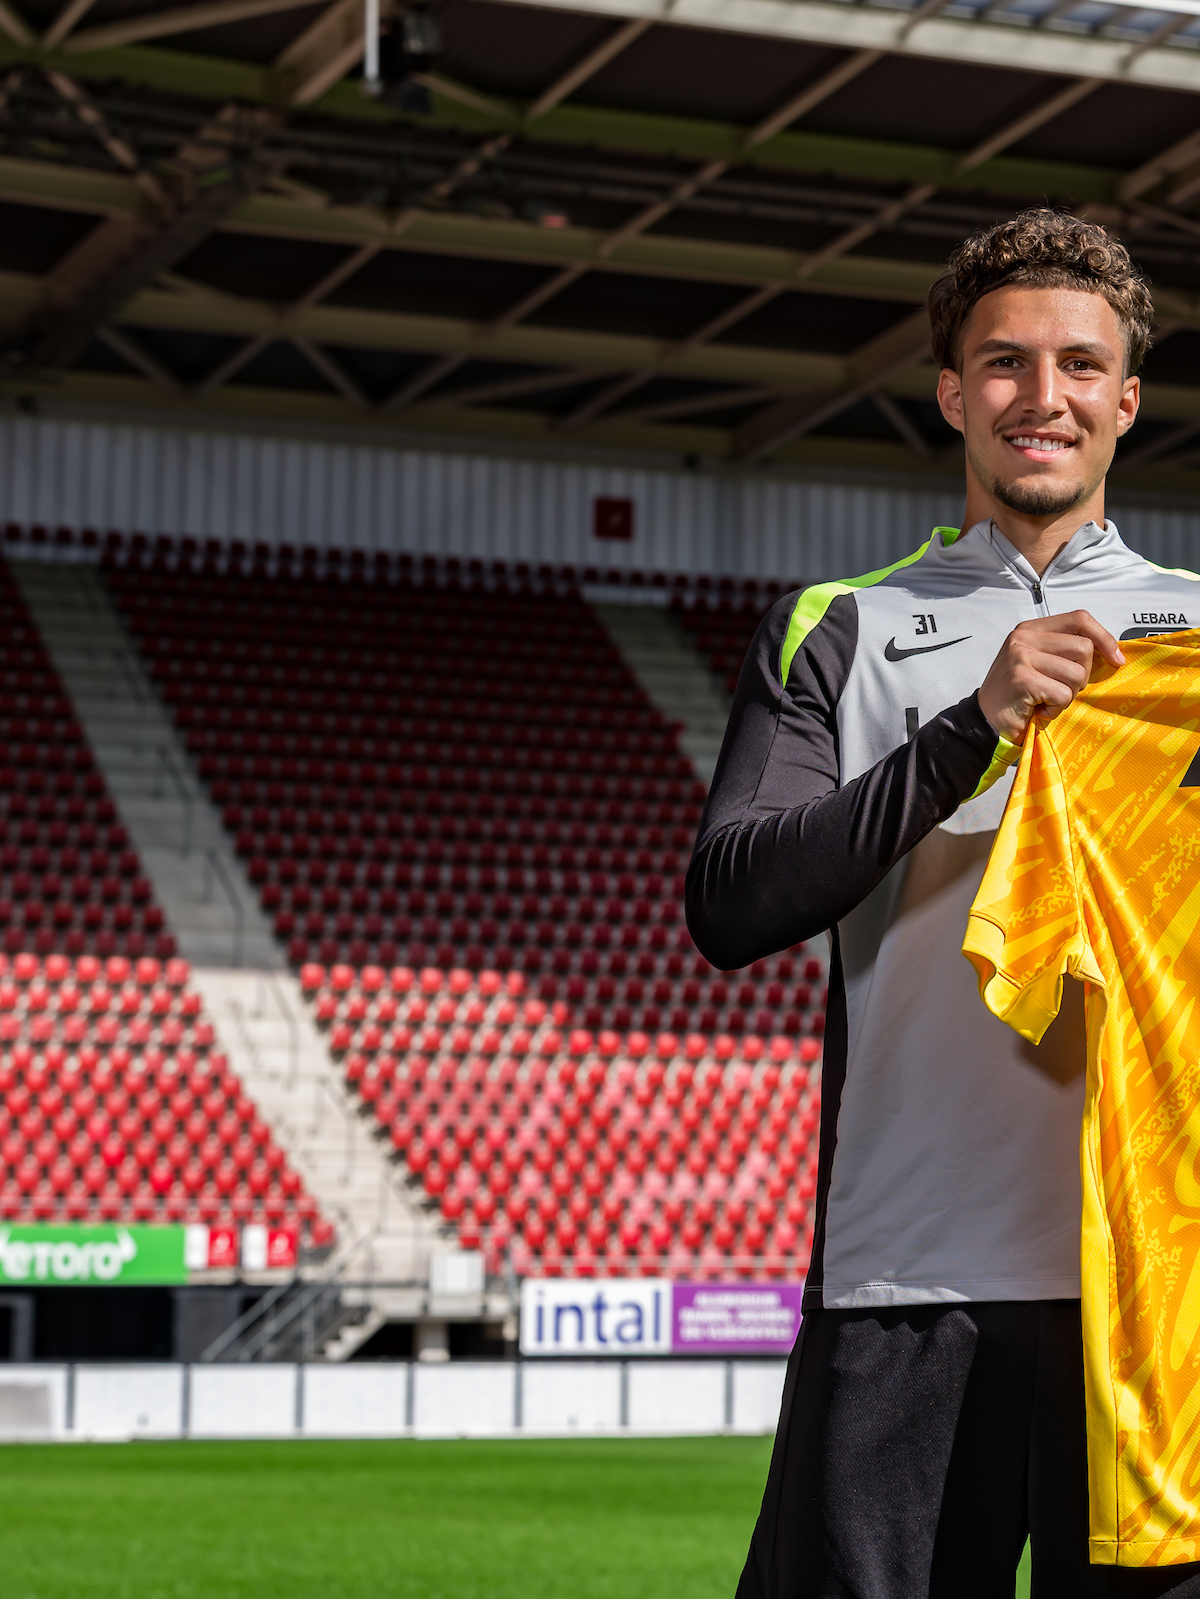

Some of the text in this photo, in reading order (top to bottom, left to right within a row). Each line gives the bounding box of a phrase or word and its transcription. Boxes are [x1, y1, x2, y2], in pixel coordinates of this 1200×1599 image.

[913, 614, 938, 635] 31
[1132, 613, 1189, 625] LEBARA
[534, 1289, 662, 1343] intal
